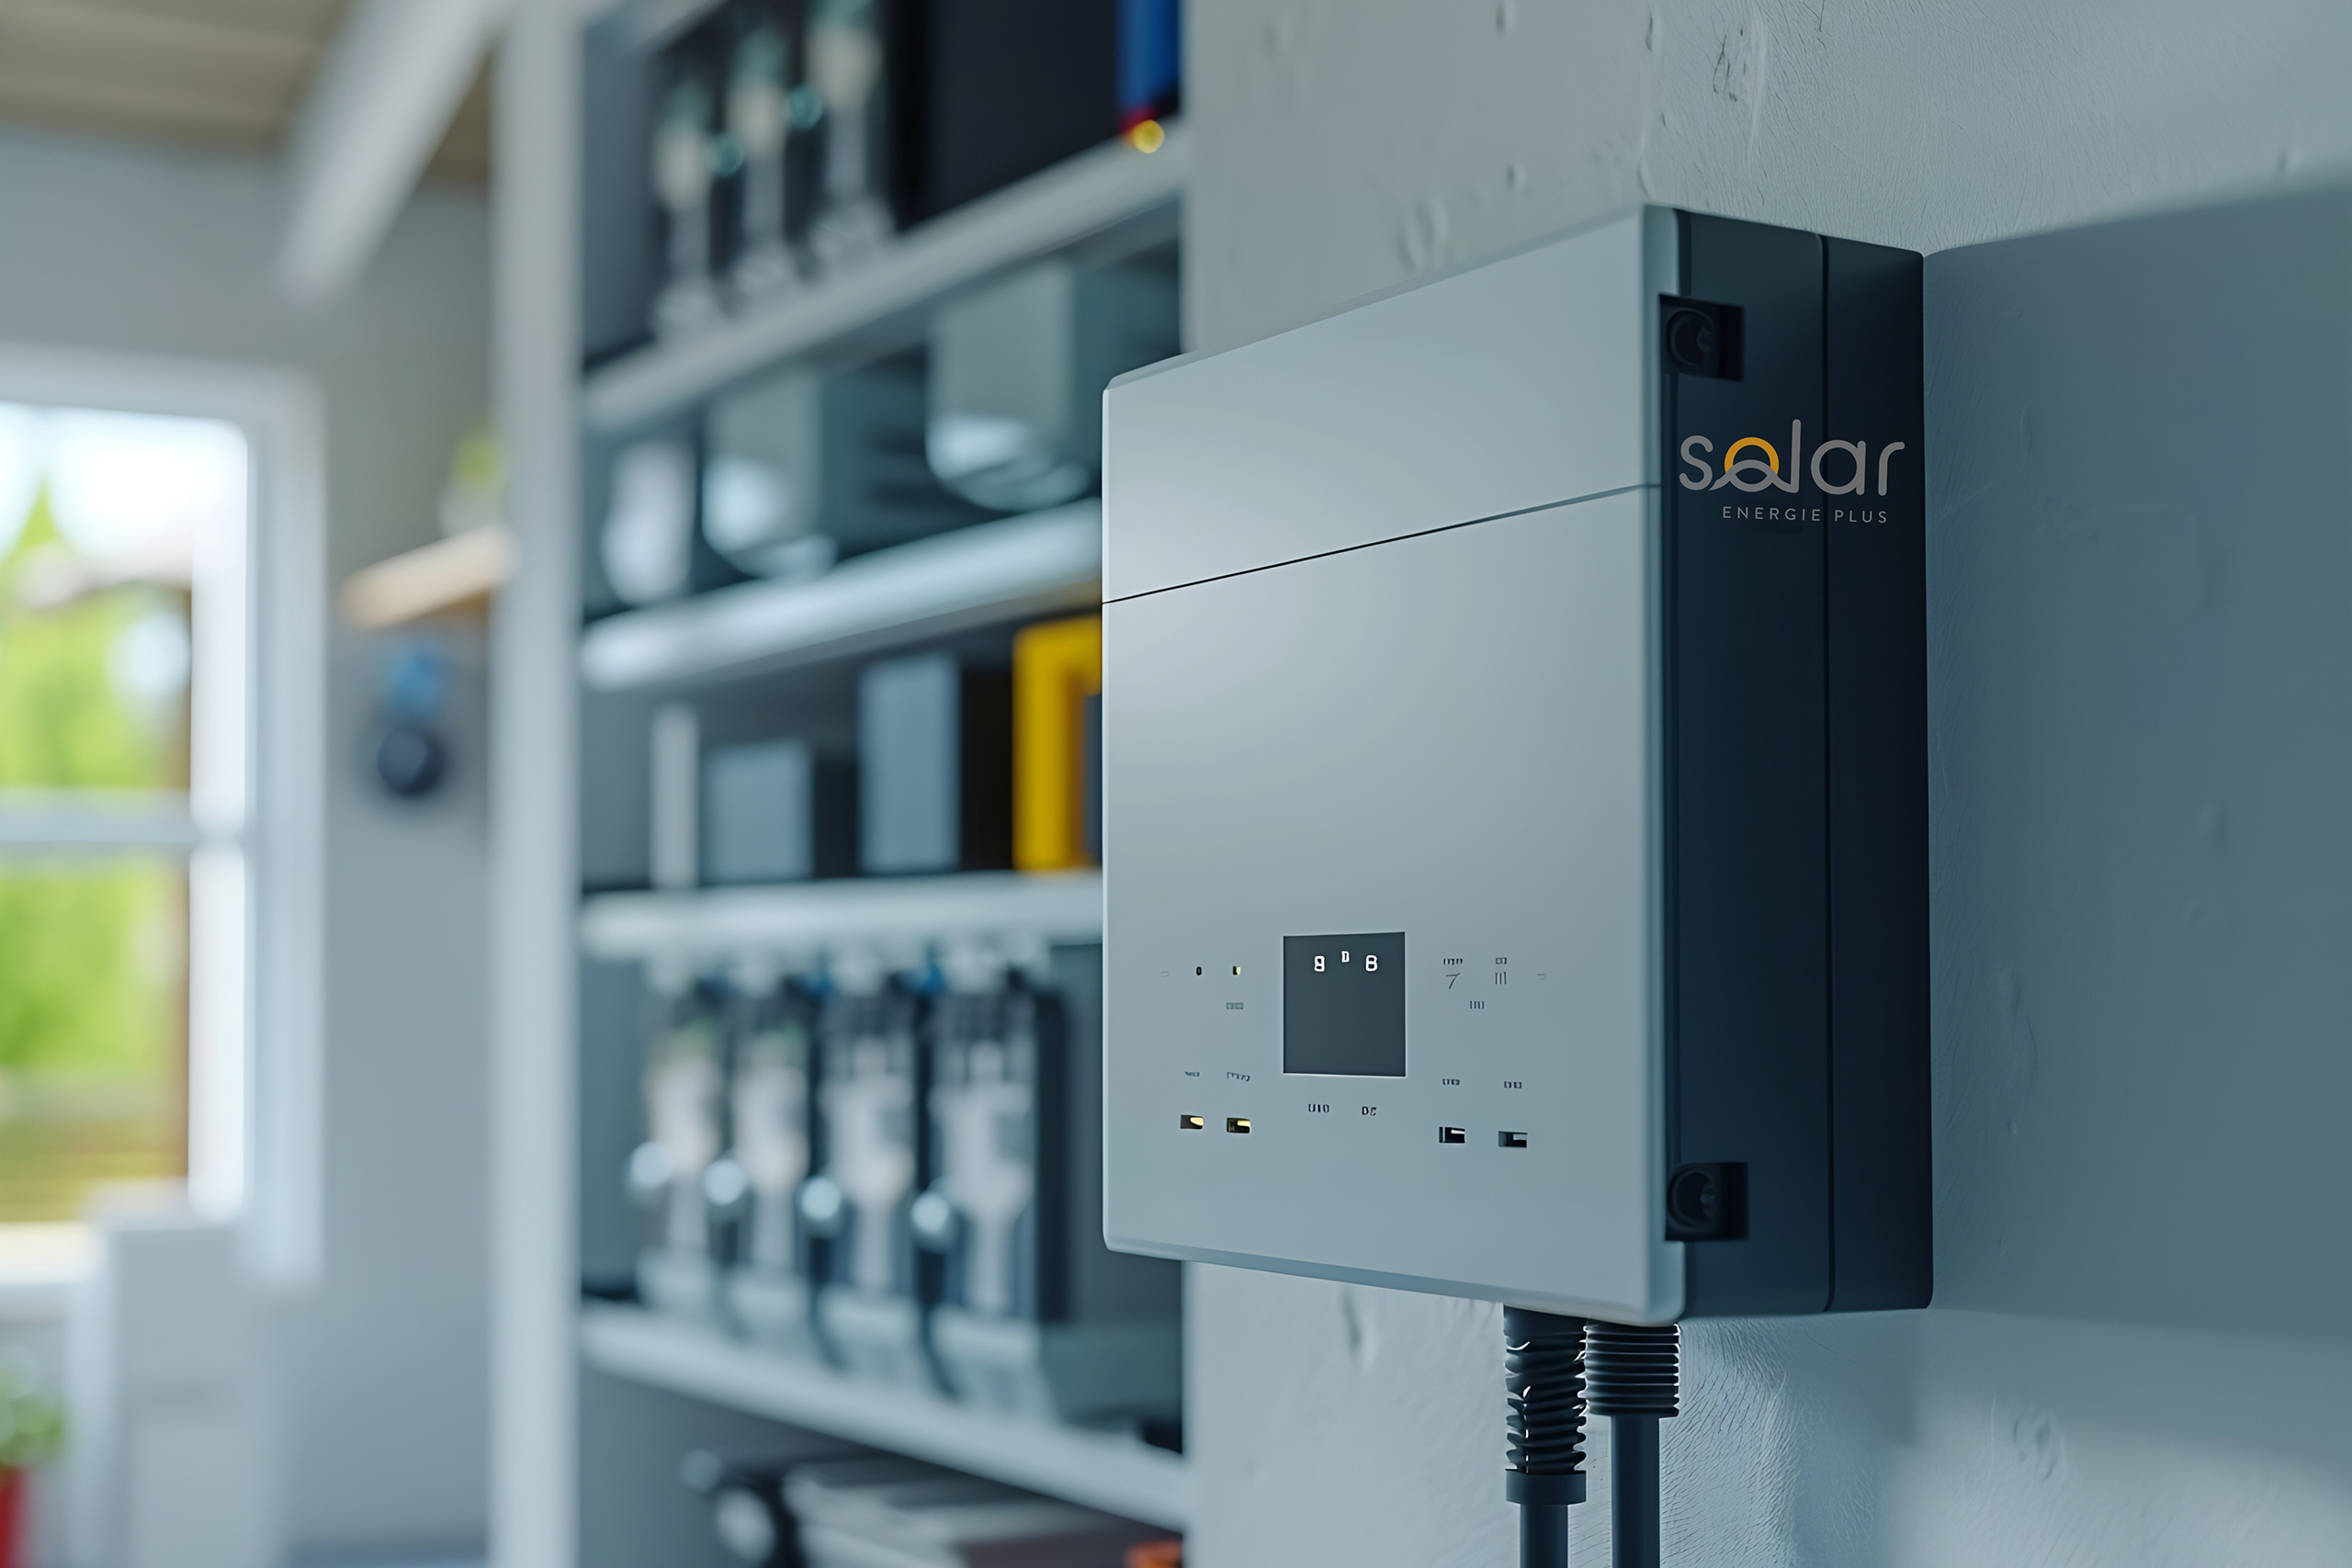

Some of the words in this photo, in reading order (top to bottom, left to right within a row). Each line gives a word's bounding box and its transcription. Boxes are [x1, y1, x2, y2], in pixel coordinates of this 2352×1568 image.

[1679, 418, 1905, 496] solar
[1722, 505, 1821, 522] ENERGIE
[1834, 509, 1888, 524] PLUS
